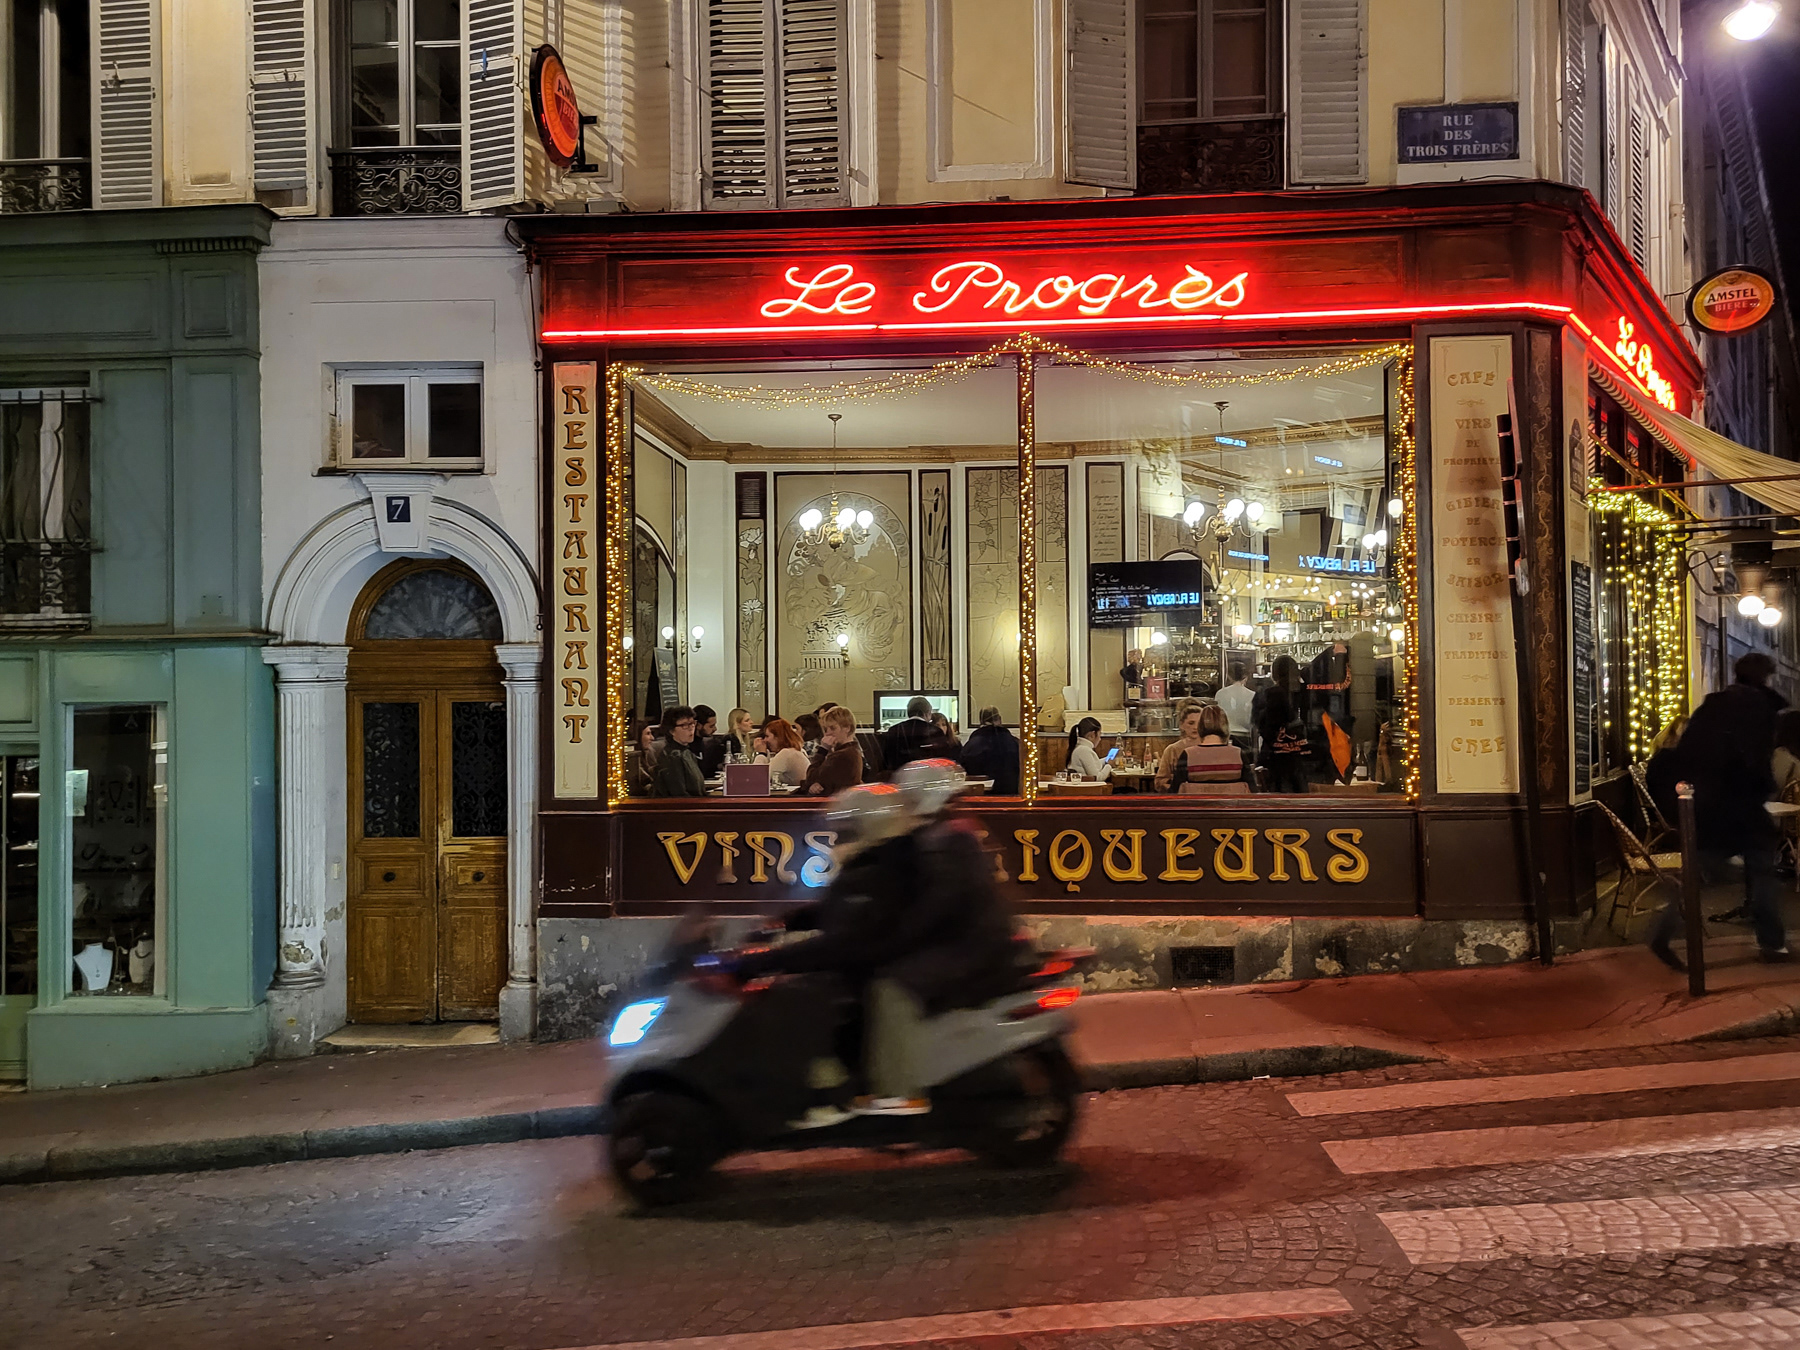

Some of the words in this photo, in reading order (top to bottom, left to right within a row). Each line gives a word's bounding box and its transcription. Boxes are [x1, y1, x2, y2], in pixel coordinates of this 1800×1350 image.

[1442, 114, 1474, 126] RUE
[1444, 130, 1472, 141] DES
[1407, 145, 1448, 157] TROIS
[1453, 140, 1510, 155] FRÈRES
[760, 263, 877, 318] Le
[912, 261, 1249, 319] Progrès
[1707, 288, 1757, 303] AMSTEL
[391, 499, 405, 520] 7
[562, 385, 591, 744] RESTAURANT
[1469, 632, 1483, 640] DE
[1448, 697, 1506, 706] DESSERTS
[1469, 719, 1483, 727] DU
[1451, 737, 1505, 757] CHEF
[656, 831, 838, 887] VINS
[975, 828, 1370, 893] IQUEURS
